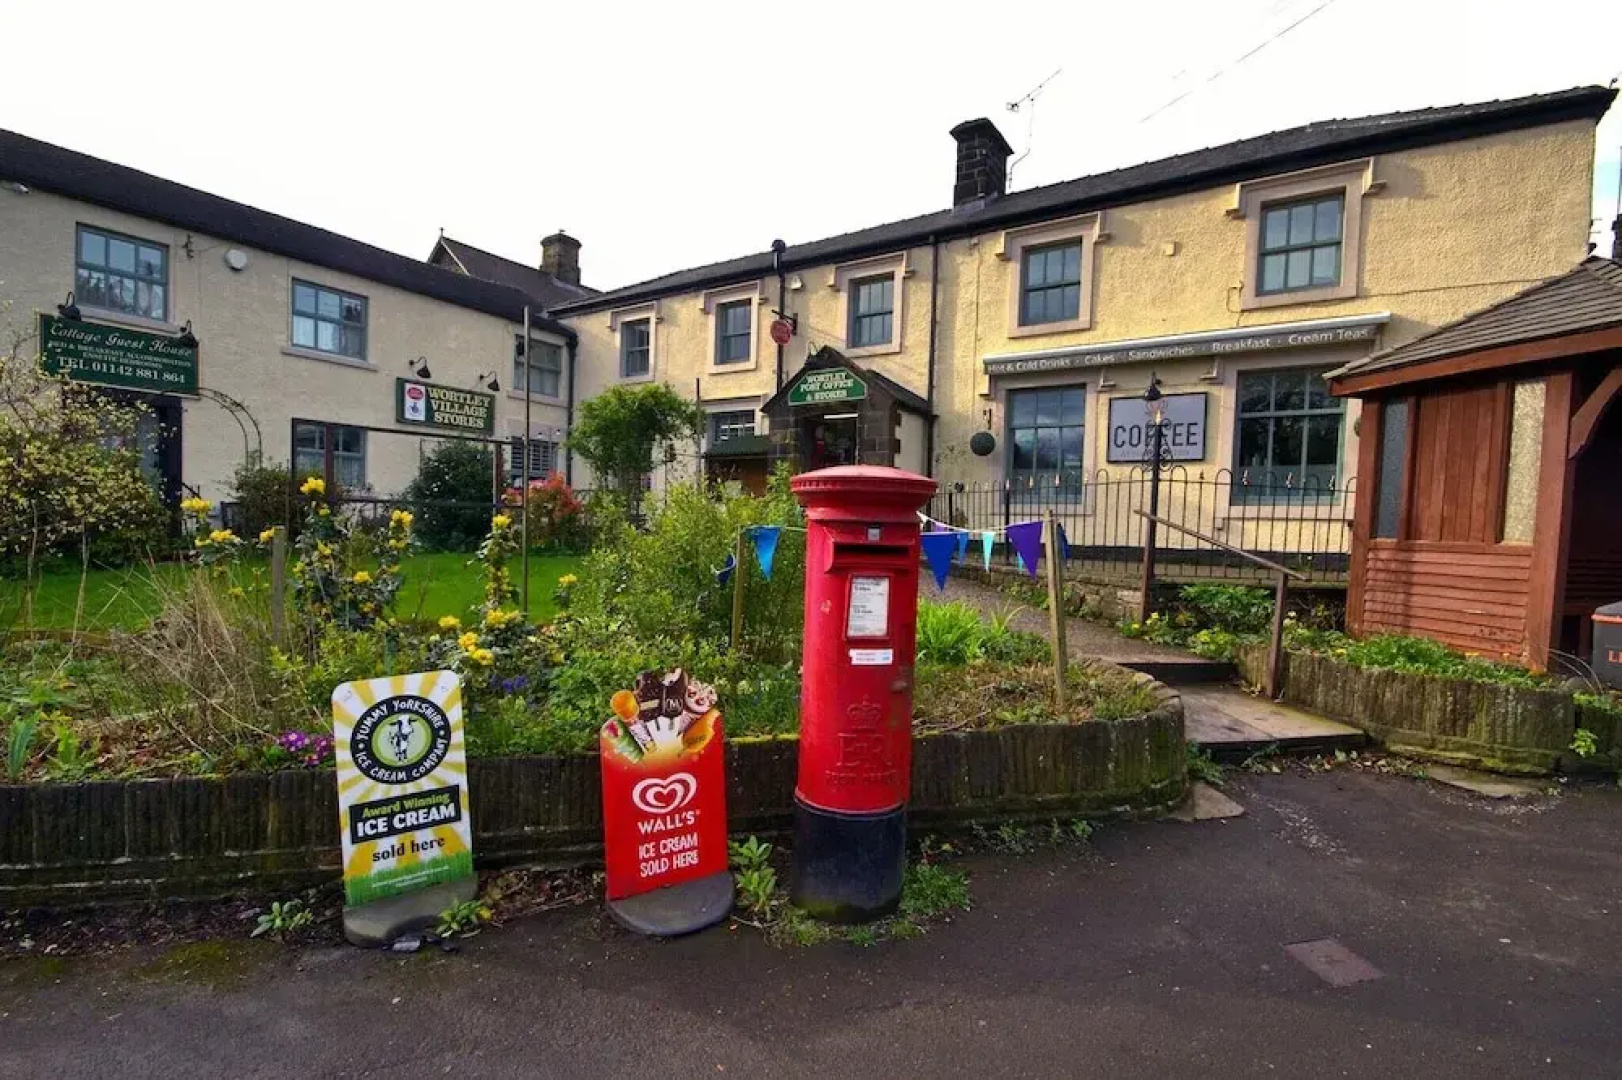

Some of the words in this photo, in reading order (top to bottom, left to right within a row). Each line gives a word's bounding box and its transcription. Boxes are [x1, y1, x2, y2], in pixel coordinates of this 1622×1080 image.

[51, 323, 101, 343] Cottage
[105, 333, 146, 350] Guest
[149, 339, 192, 357] House
[1006, 363, 1015, 372] &
[1017, 360, 1036, 371] Cold
[1040, 358, 1071, 369] Drinks
[1085, 354, 1115, 364] Cakes
[1128, 345, 1195, 359] Sandwiches
[1212, 338, 1271, 353] Breakfast
[1288, 331, 1333, 346] Cream
[1337, 327, 1369, 340] Teas
[92, 362, 133, 376] 01142
[135, 368, 158, 380] 881
[162, 372, 185, 384] 864
[800, 382, 820, 393] POST
[822, 378, 854, 390] OFFICE
[806, 372, 847, 384] WORTLEY
[427, 387, 491, 408] WORTLEY
[814, 389, 848, 401] STORES
[431, 398, 488, 418] VILLAGE
[434, 411, 485, 429] STORES
[1113, 421, 1199, 449] COFFEE
[356, 703, 389, 741] YUMMY
[392, 698, 445, 729] YORKSHIRE
[355, 752, 372, 769] ICE
[370, 767, 407, 783] CREAM
[411, 737, 449, 778] COMPANY
[362, 801, 400, 818] Award
[403, 793, 450, 810] Winning
[356, 817, 388, 838] ICE
[393, 802, 455, 829] CREAM
[637, 810, 696, 836] WALL'S
[372, 842, 405, 862] sold
[411, 837, 446, 853] here
[638, 842, 656, 860] ICE
[659, 832, 698, 855] CREAM
[639, 857, 669, 878] SOLD
[672, 849, 699, 870] HERE
